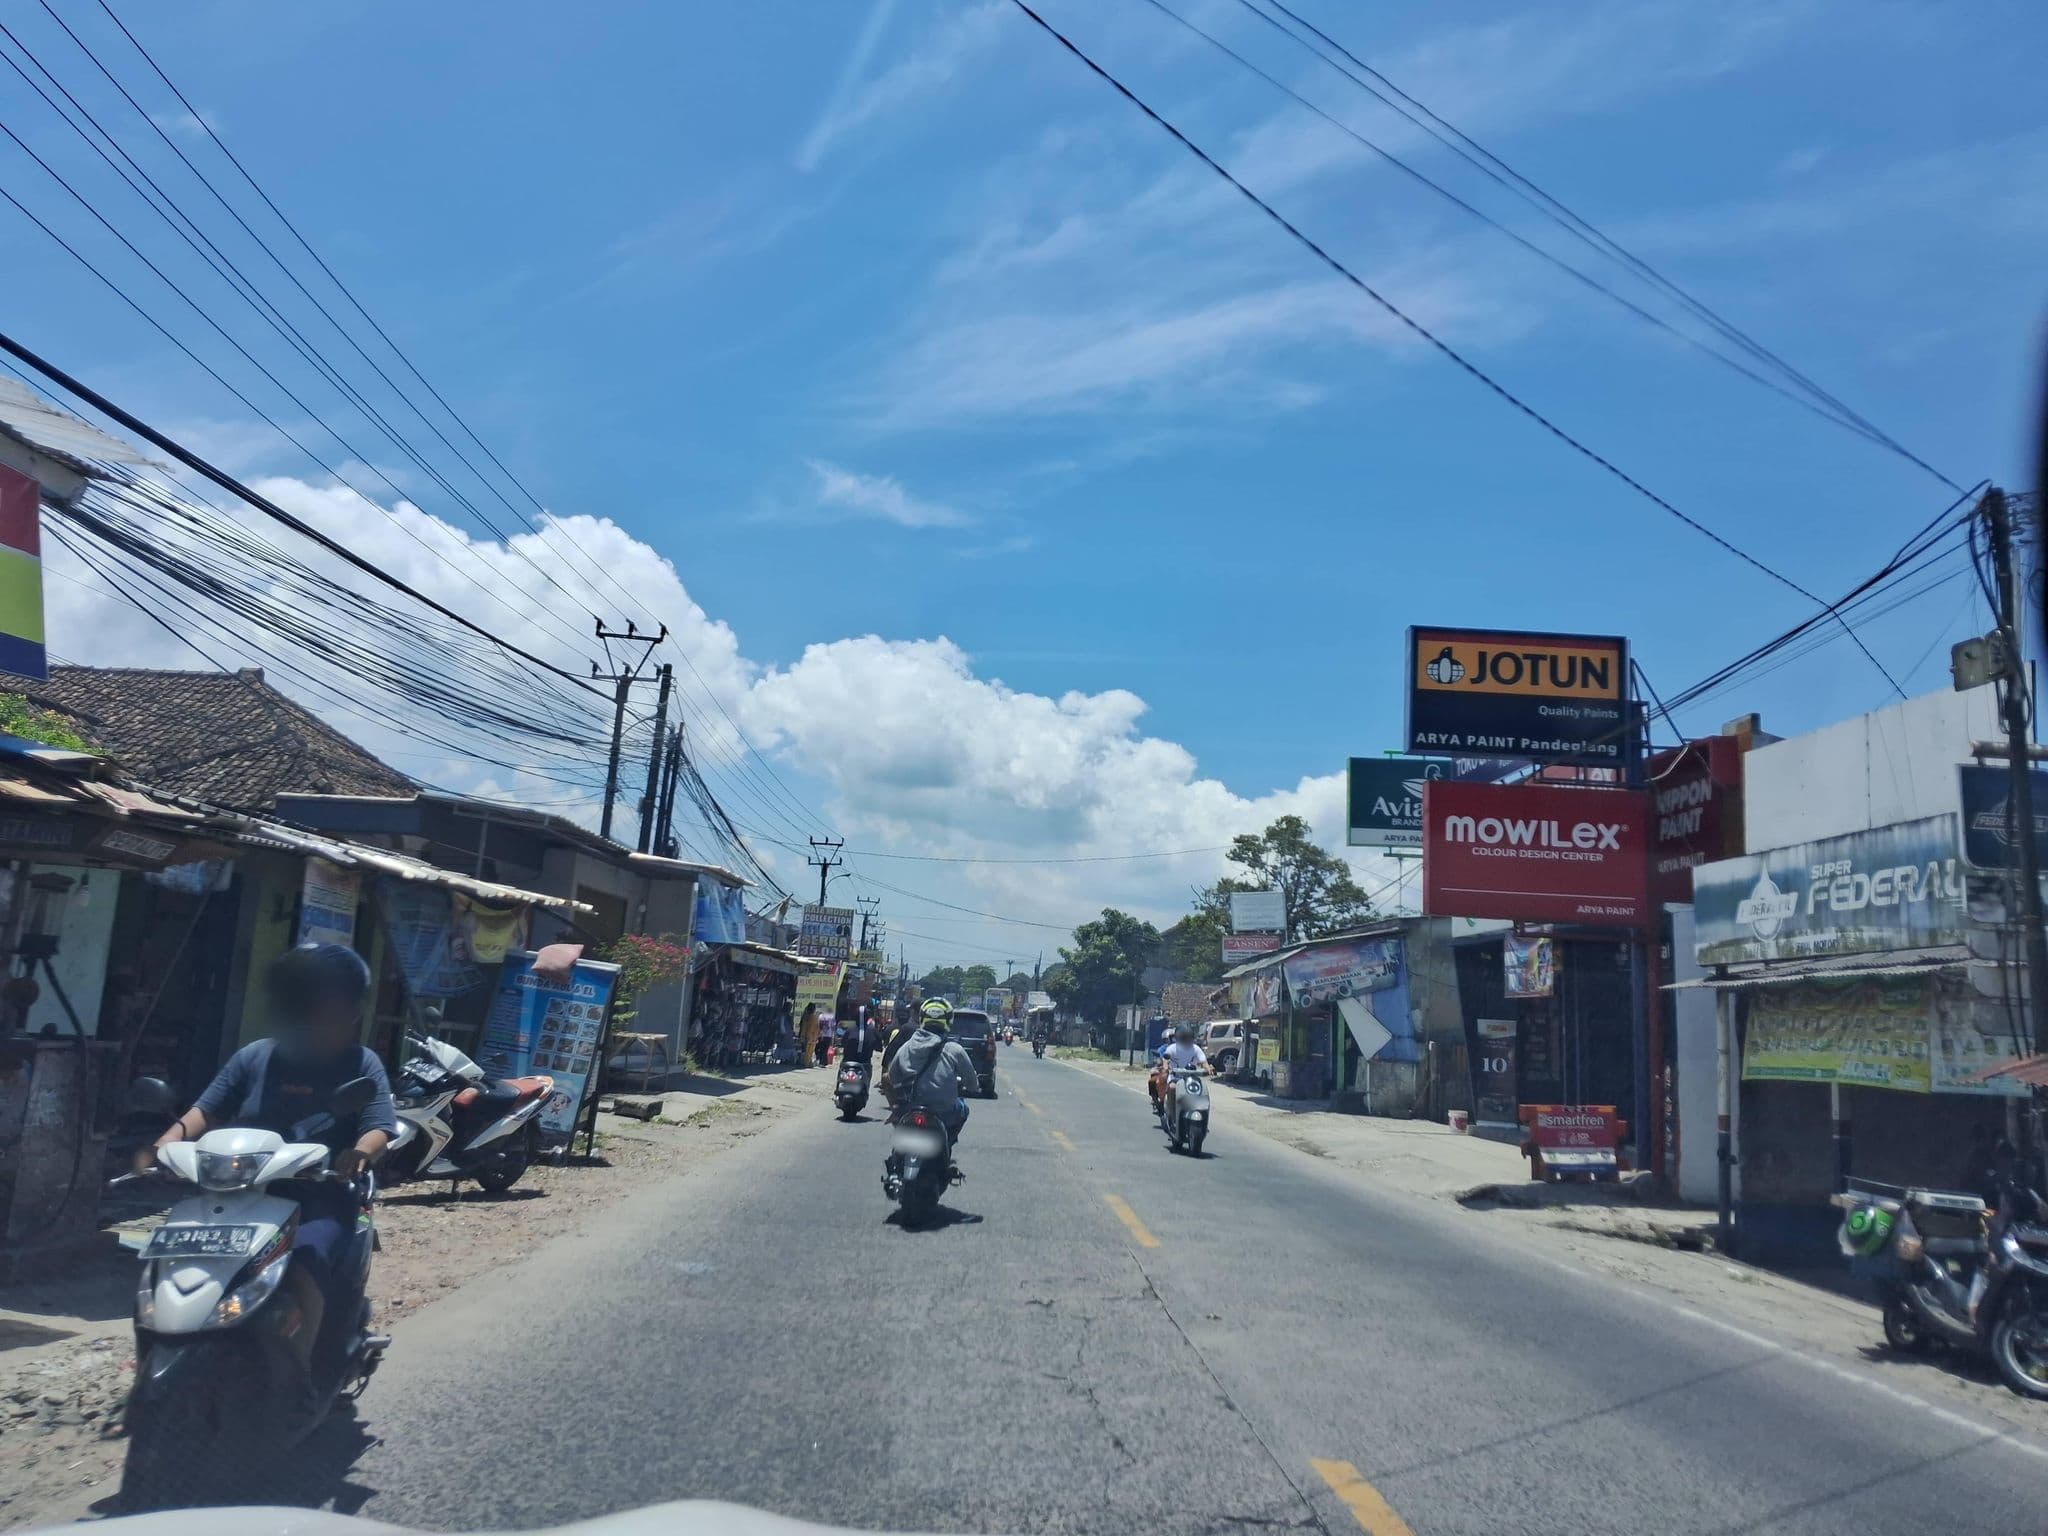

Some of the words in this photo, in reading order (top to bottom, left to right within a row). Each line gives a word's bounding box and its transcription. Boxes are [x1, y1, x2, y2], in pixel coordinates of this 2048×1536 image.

[1469, 650, 1610, 691] JOTUN
[1537, 705, 1580, 719] Quality
[1583, 707, 1618, 719] Paints
[1416, 732, 1461, 746] ARYA
[1466, 735, 1515, 749] PAINT
[1659, 806, 1704, 841] PAINT
[1472, 847, 1517, 858] COLOUR
[1519, 849, 1560, 861] DESIGN
[1561, 851, 1603, 862] CENTER
[1810, 859, 1852, 880] SUPER
[1807, 858, 1963, 916] FEDERAL
[1576, 904, 1604, 915] ARYA
[1605, 905, 1636, 917] PAINT
[804, 914, 852, 925] COLLECTION
[801, 935, 848, 948] SERBA
[583, 986, 594, 996] EL
[1481, 1057, 1508, 1073] 10
[1546, 1113, 1605, 1126] smartfren
